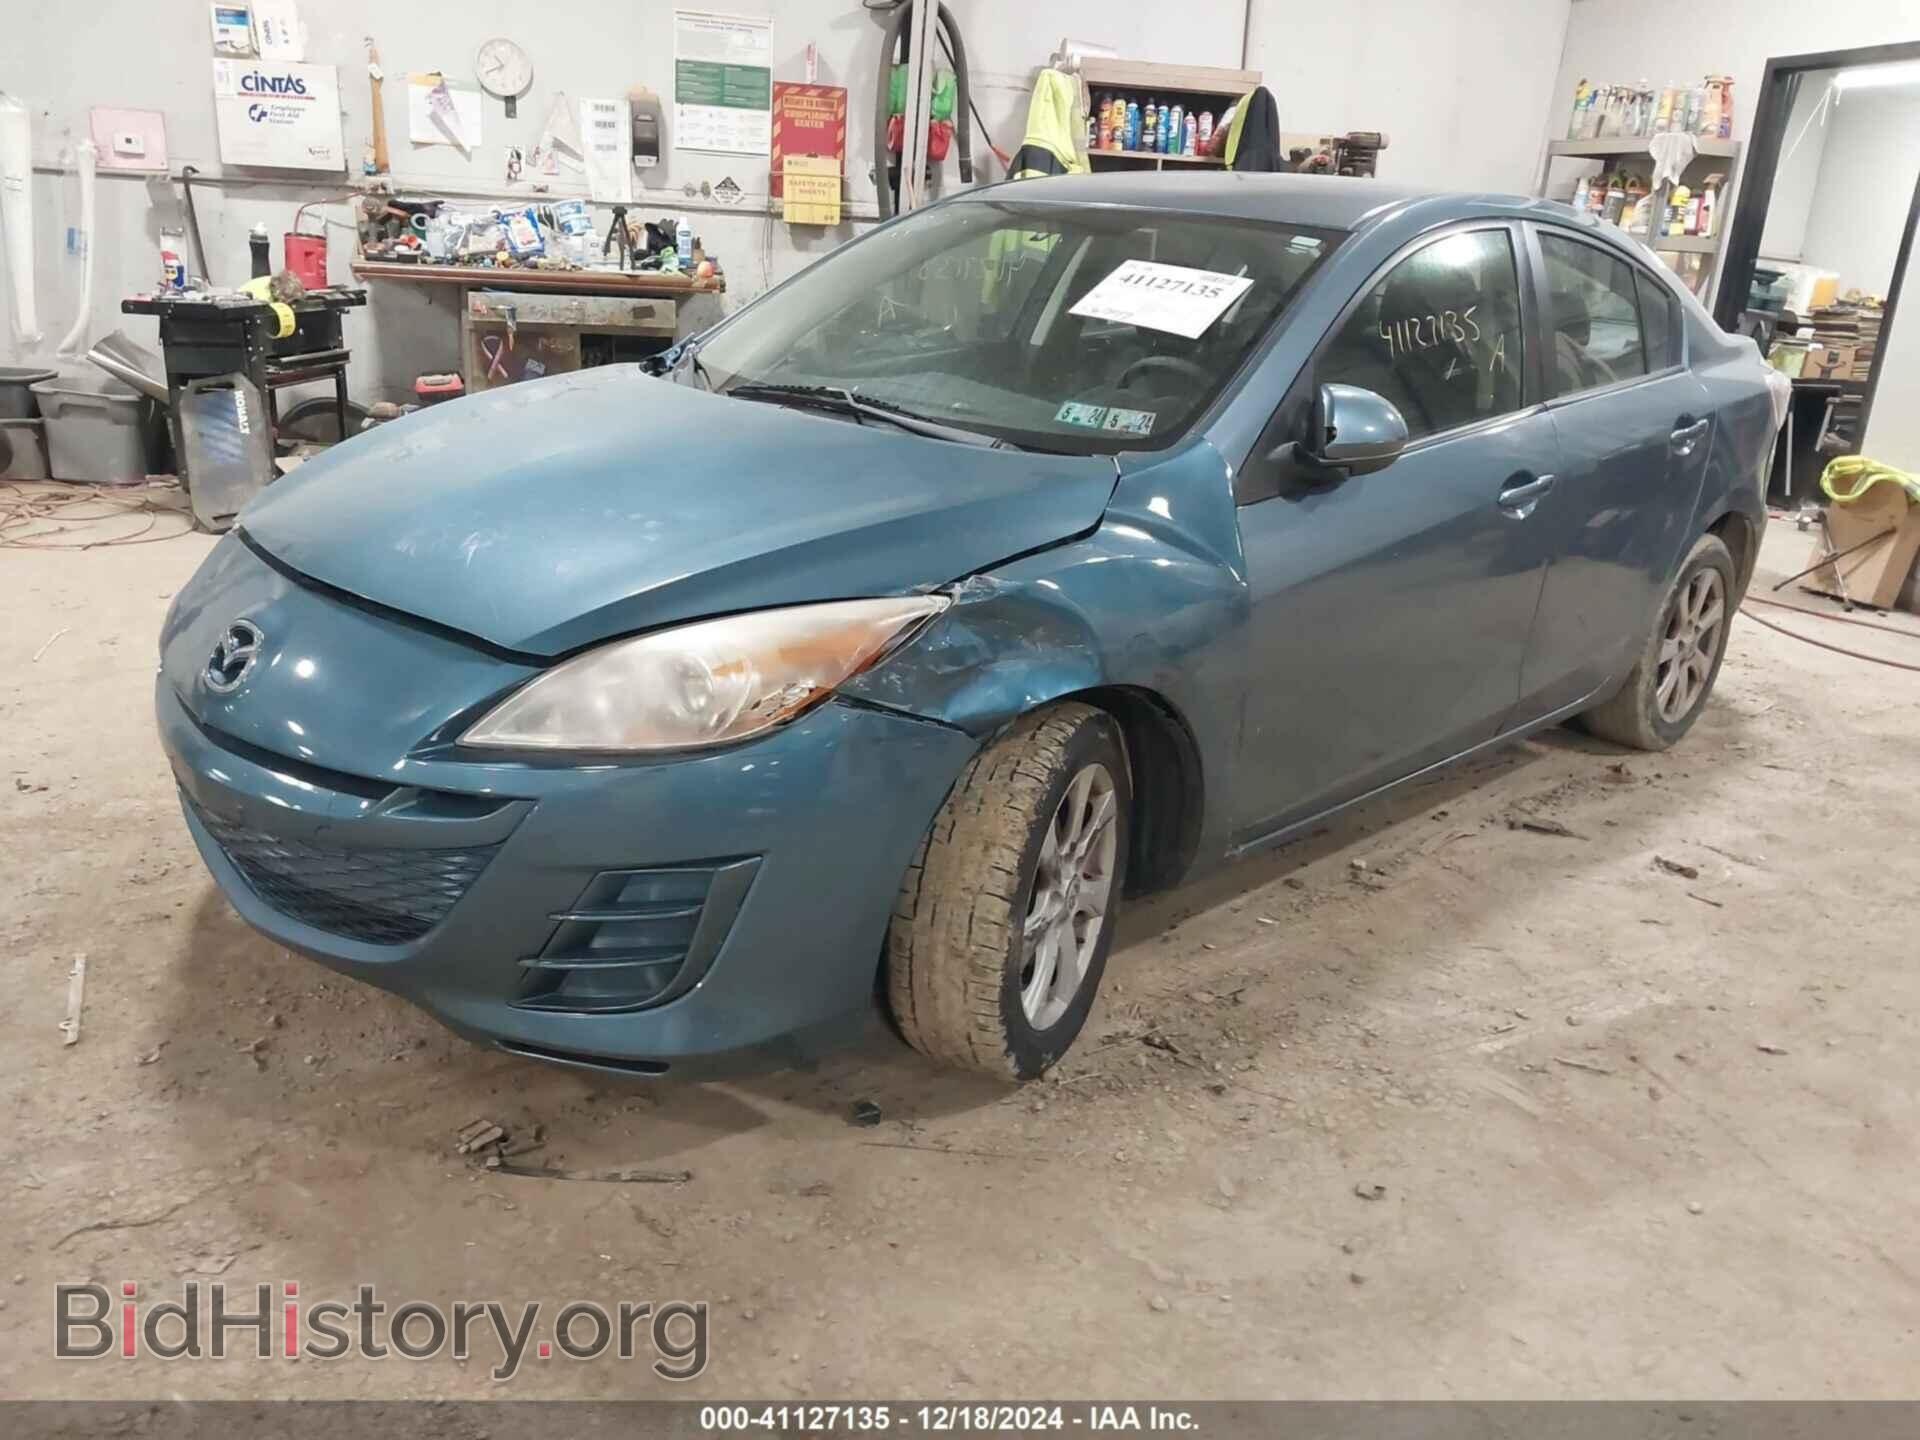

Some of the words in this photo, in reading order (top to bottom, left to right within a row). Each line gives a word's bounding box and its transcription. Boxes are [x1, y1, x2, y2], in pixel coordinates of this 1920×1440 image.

[241, 70, 306, 94] CINTAS
[784, 109, 835, 121] COMPLIANCE
[794, 118, 825, 129] CENTER
[1120, 273, 1224, 299] 41127135
[1379, 305, 1480, 360] 41127135
[1489, 333, 1505, 373] A
[1062, 407, 1073, 420] 5
[1088, 408, 1104, 424] 24
[1110, 414, 1120, 428] 5
[1137, 414, 1152, 432] 24
